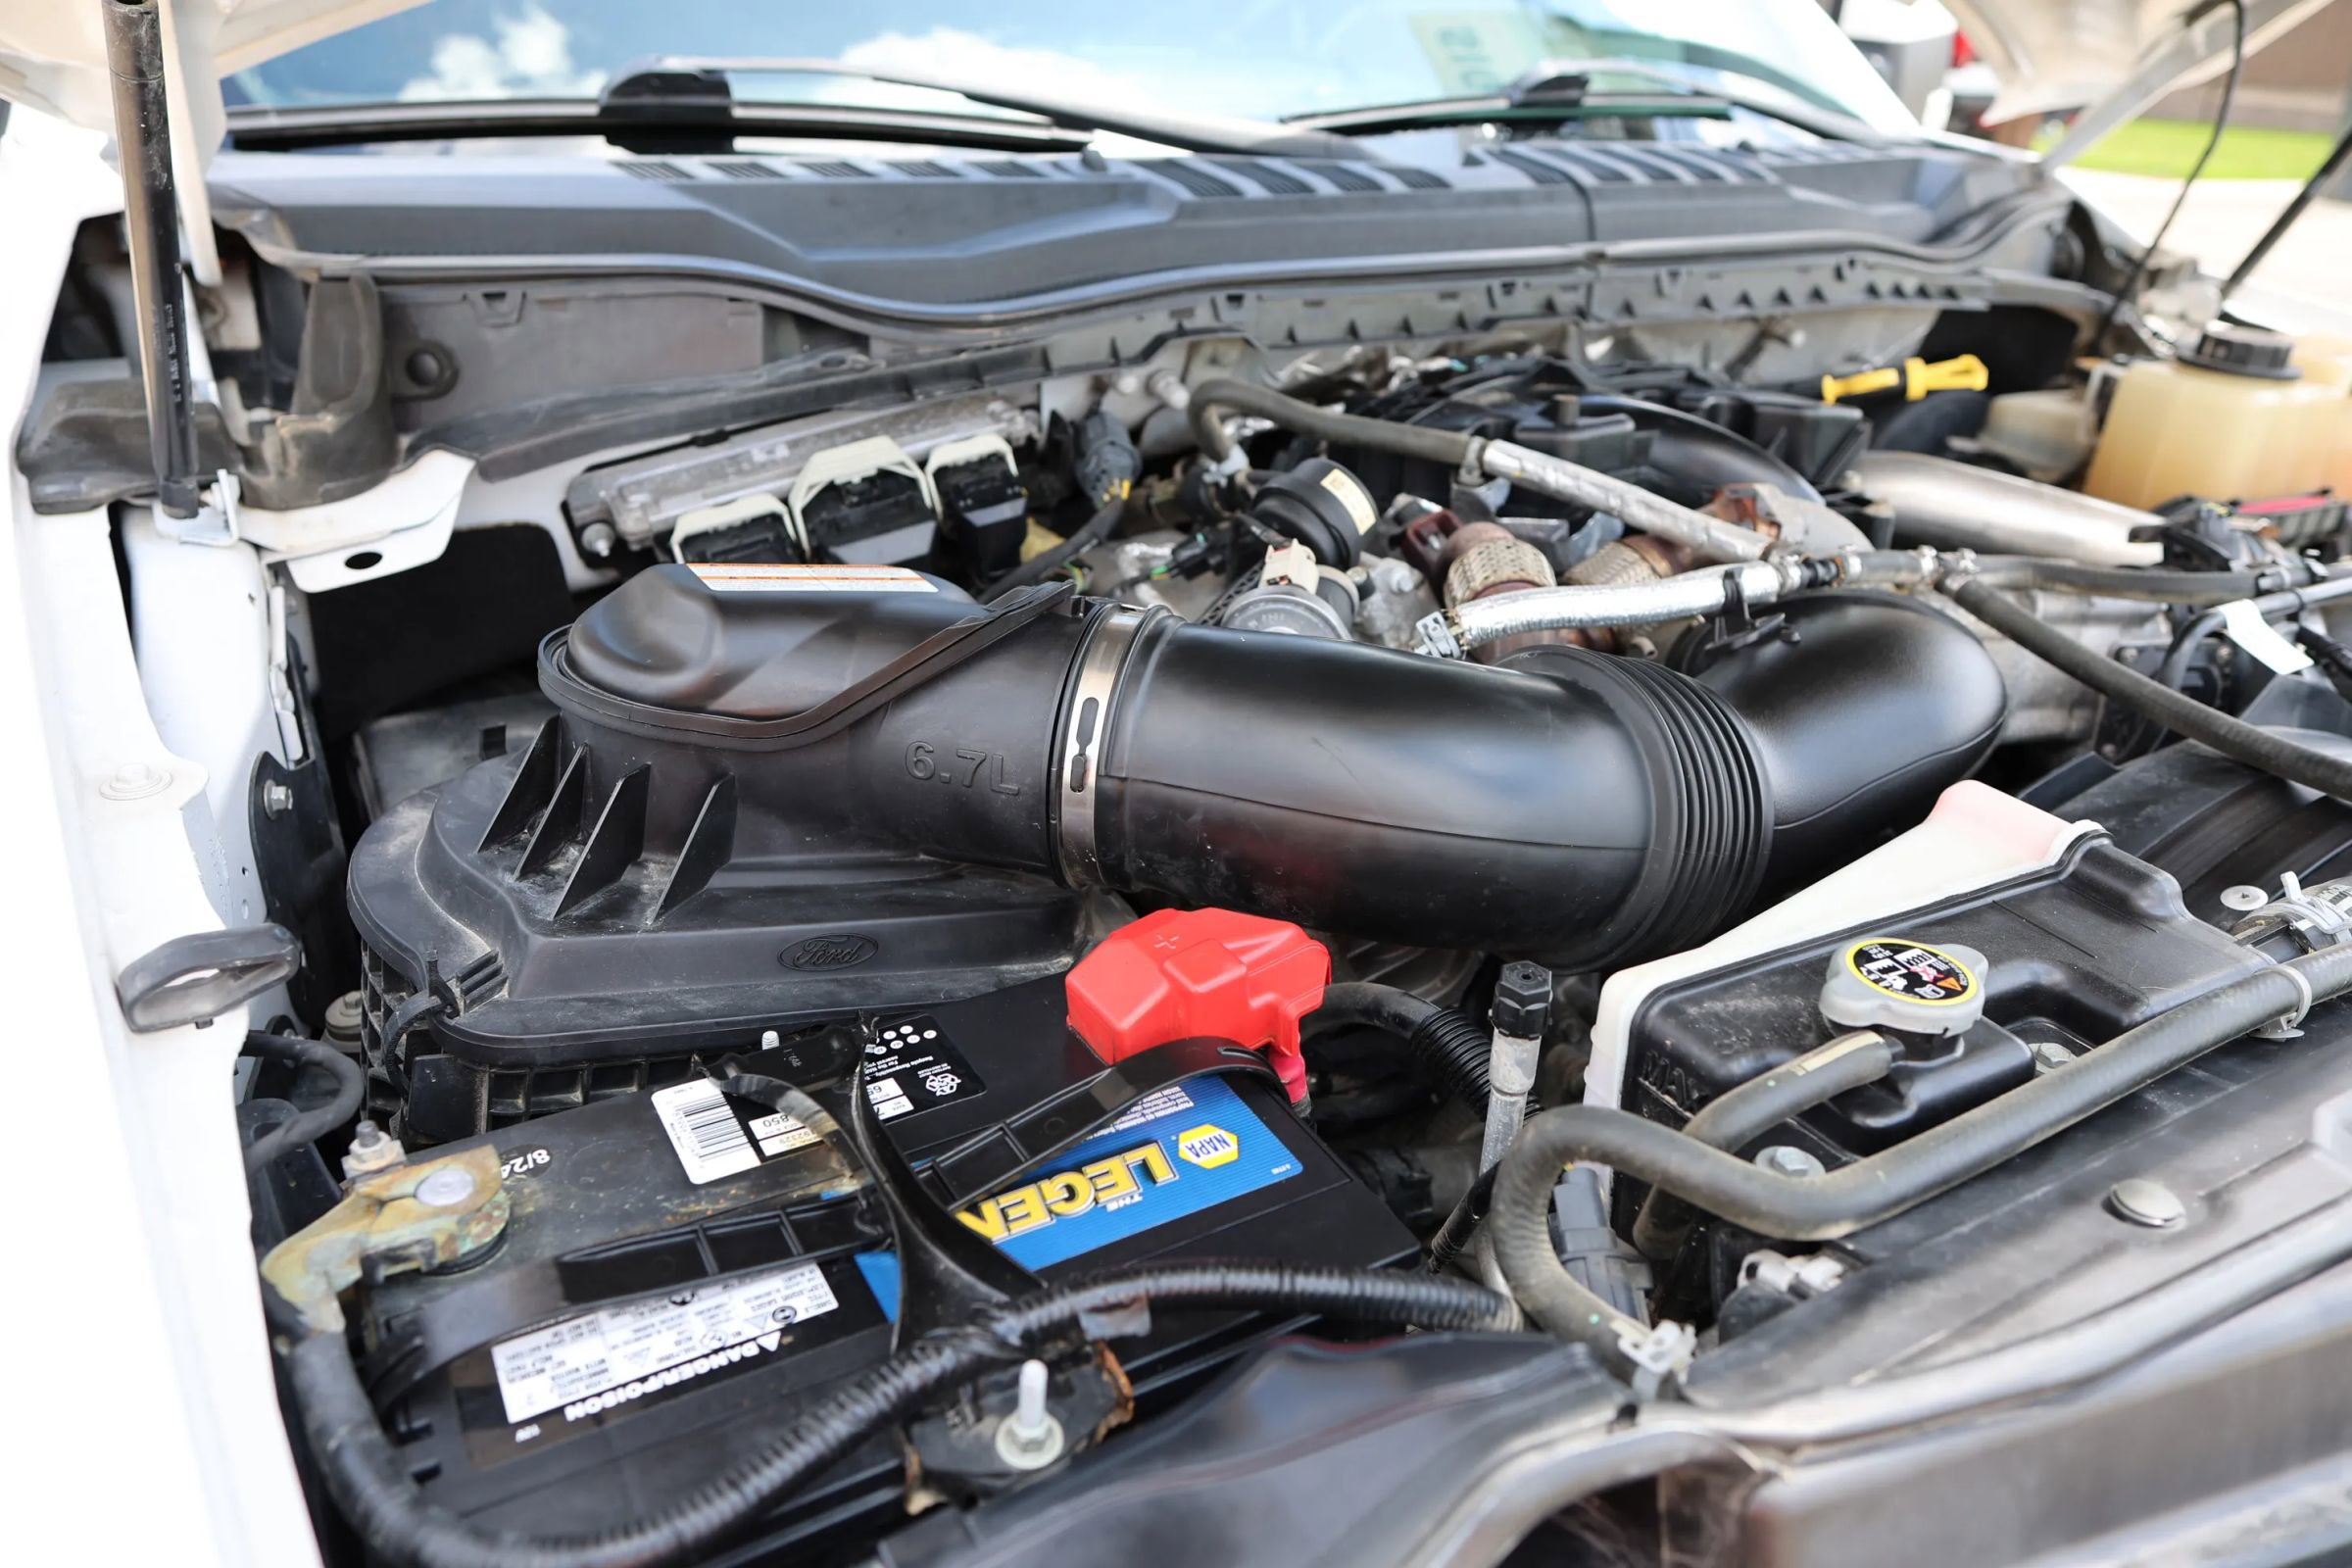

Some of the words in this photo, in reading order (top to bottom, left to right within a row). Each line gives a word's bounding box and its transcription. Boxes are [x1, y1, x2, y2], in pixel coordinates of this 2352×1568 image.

[906, 741, 1019, 796] 6.7L
[793, 936, 865, 969] Ford
[909, 1055, 933, 1065] Recycle
[1184, 1132, 1230, 1159] NAPA
[1104, 1192, 1143, 1212] THE
[563, 1339, 760, 1422] DANGER/POISON
